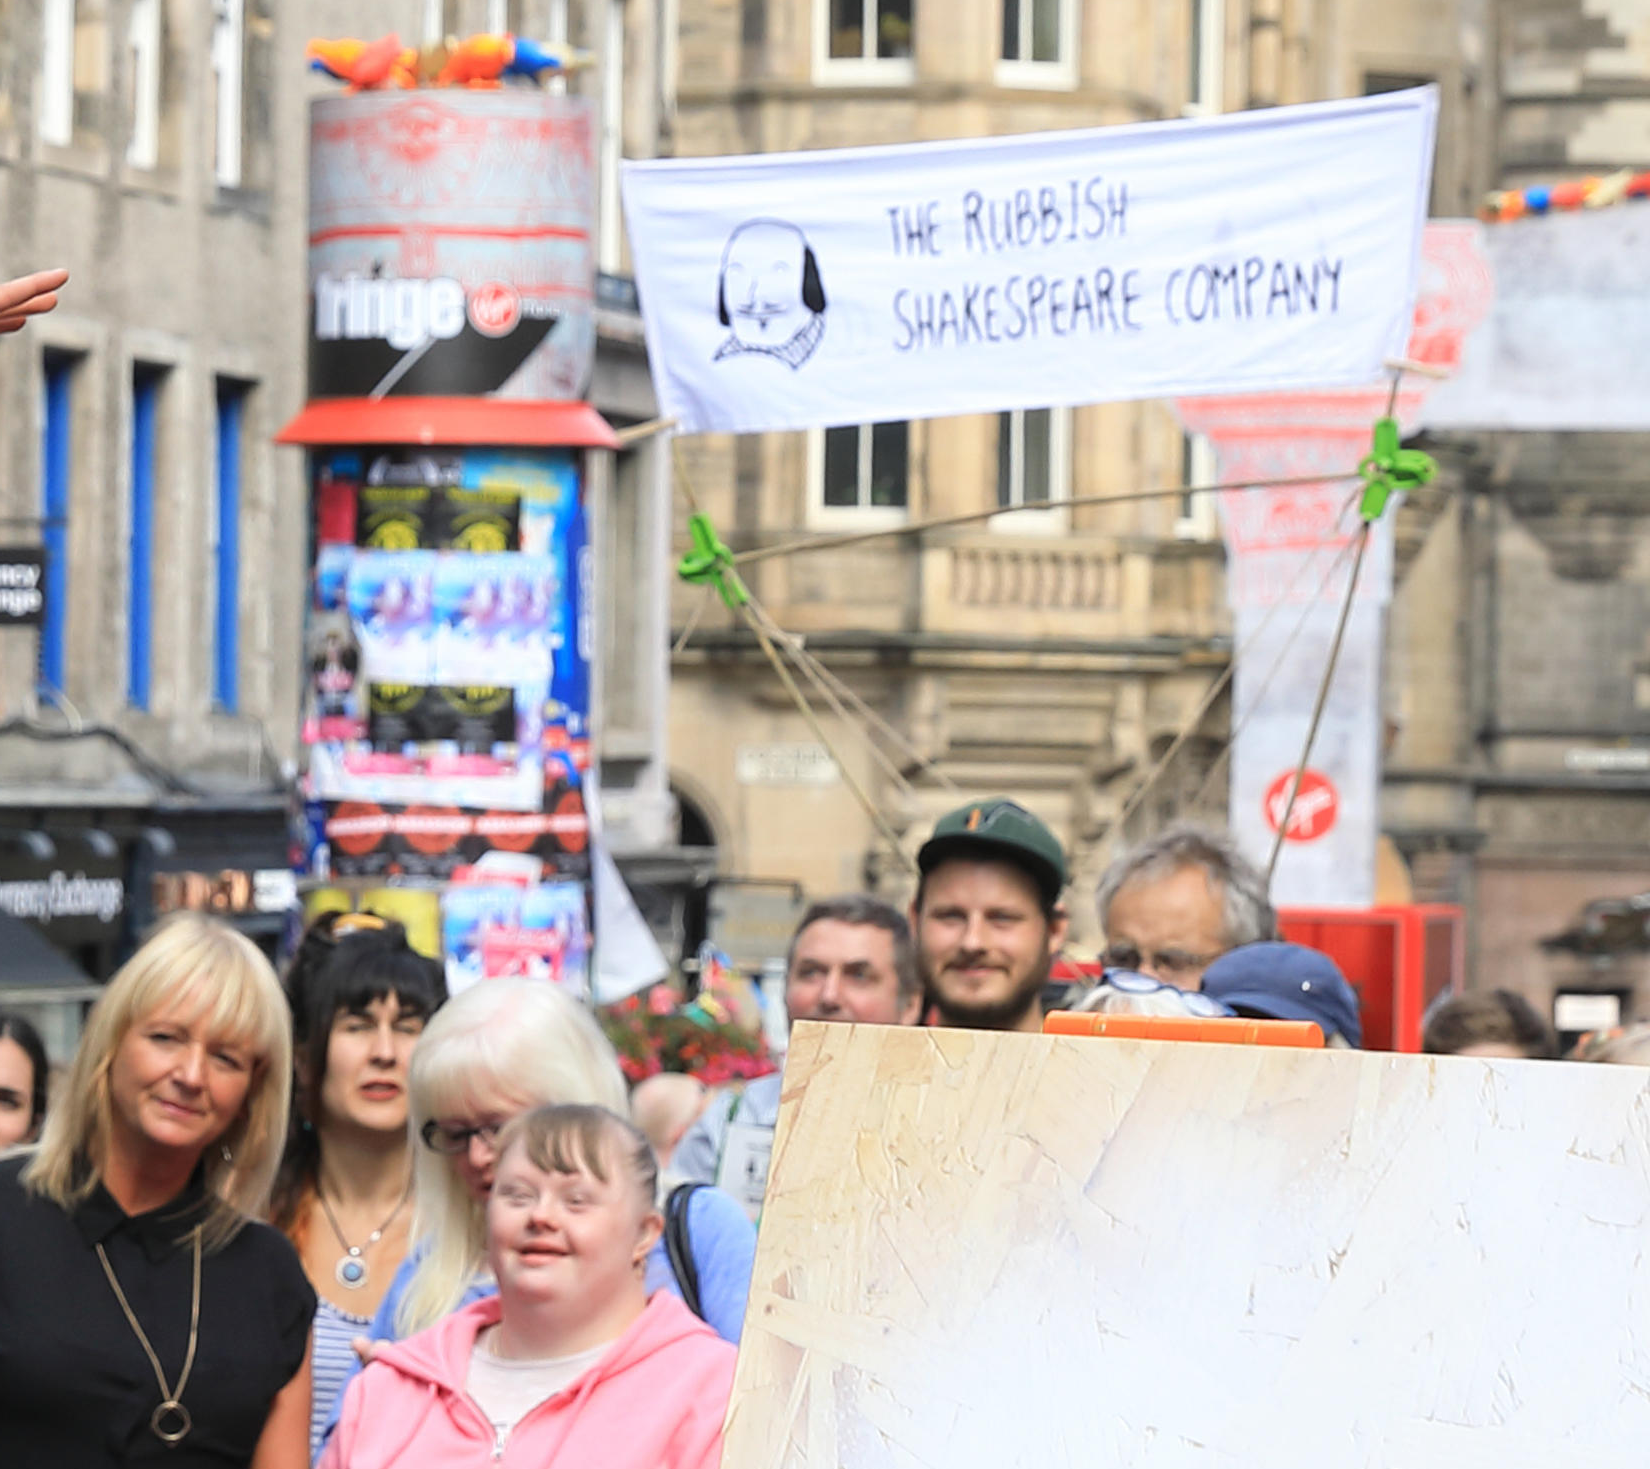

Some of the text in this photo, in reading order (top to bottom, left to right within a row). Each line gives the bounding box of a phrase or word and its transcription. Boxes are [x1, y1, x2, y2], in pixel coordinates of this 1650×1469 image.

[886, 175, 1130, 259] THE RUBBISH
[892, 256, 1343, 353] SHAKESPEARE COMPANY
